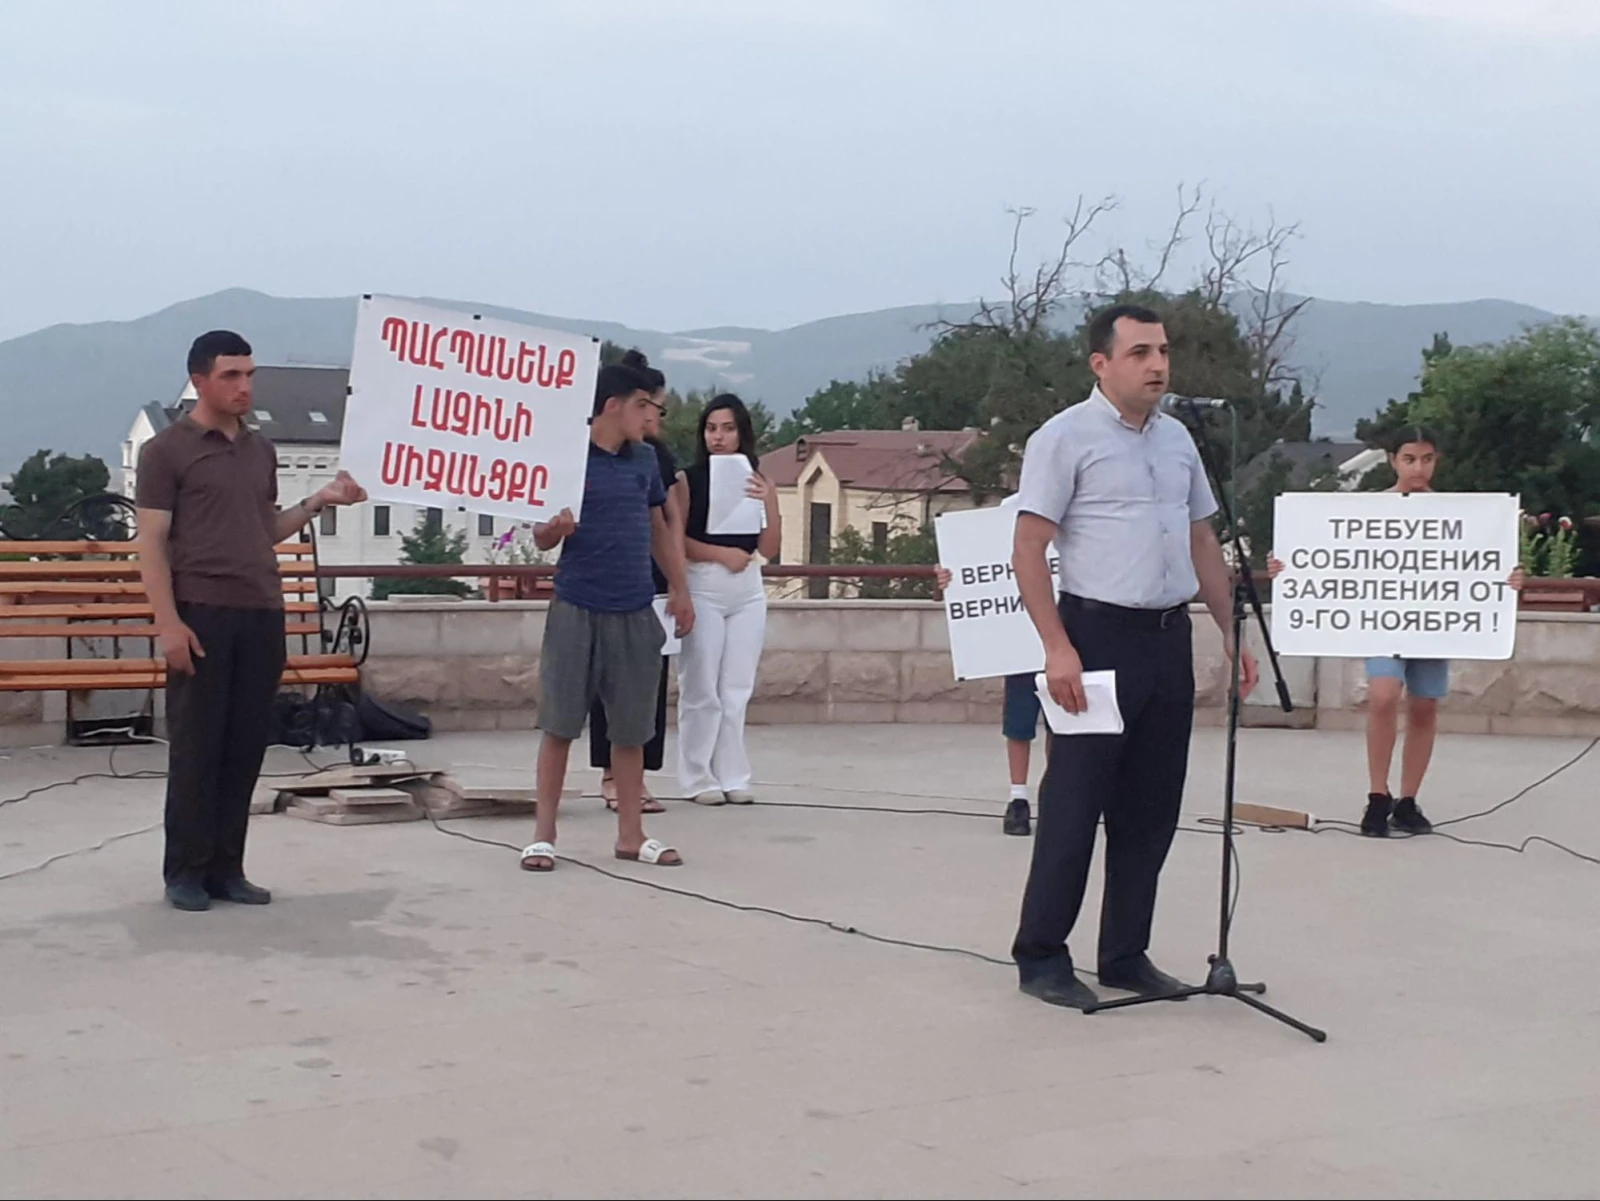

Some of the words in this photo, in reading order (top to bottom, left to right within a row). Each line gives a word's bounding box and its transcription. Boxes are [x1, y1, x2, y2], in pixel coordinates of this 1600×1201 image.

[381, 317, 576, 389] ՊԱՀՊԱՆԵՆՔ
[411, 385, 533, 443] ԼԱՉԻՆԻ
[381, 441, 549, 507] ՄԻՋԱՆՑՔԸ
[1329, 518, 1463, 540] ТРЕБУЕМ
[1291, 548, 1500, 574] СОБЛЮДЕНИЯ
[1282, 578, 1460, 601] ЗАЯВЛЕНИЯ
[1469, 580, 1509, 601] ОТ
[1289, 609, 1351, 631] 9-ГО
[1360, 610, 1481, 633] НОЯБРЯ
